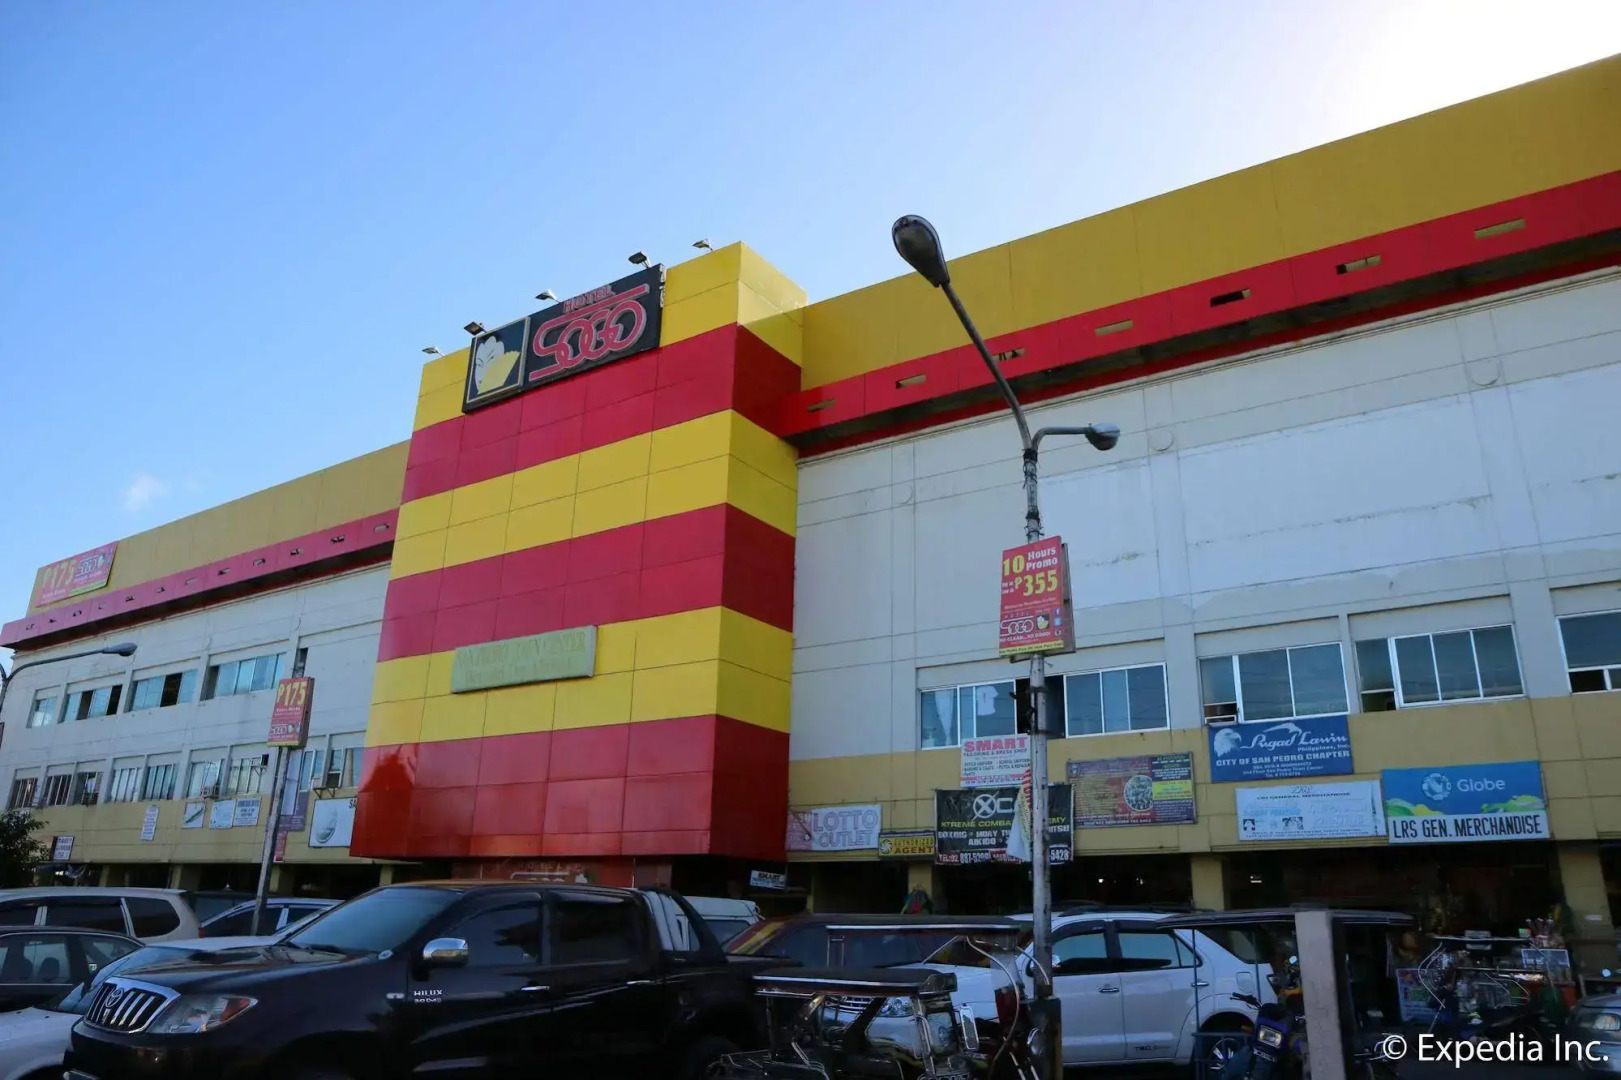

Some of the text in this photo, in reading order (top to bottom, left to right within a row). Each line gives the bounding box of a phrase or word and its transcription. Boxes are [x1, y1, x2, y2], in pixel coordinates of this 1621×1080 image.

[562, 285, 616, 313] HOTEL
[529, 283, 650, 382] SOGO
[1028, 547, 1057, 560] Hours
[1003, 555, 1026, 576] 10
[1026, 557, 1058, 571] Promo
[1000, 615, 1034, 637] SOGO
[964, 737, 1028, 752] SMART
[1216, 750, 1350, 767] CITY OF SAN PEDRO CHAPTER
[1457, 779, 1506, 792] Globe
[813, 810, 878, 831] LOTTO
[1393, 819, 1418, 839] LRS
[1422, 818, 1452, 838] GEN.
[1454, 814, 1542, 837] MERCHANDISE
[818, 829, 873, 848] OUTLET
[894, 838, 934, 846] AUTHORIZED
[938, 831, 968, 839] BOXING
[976, 830, 998, 838] MUAY
[968, 838, 996, 846] AIKIDO
[894, 845, 933, 854] AGENT
